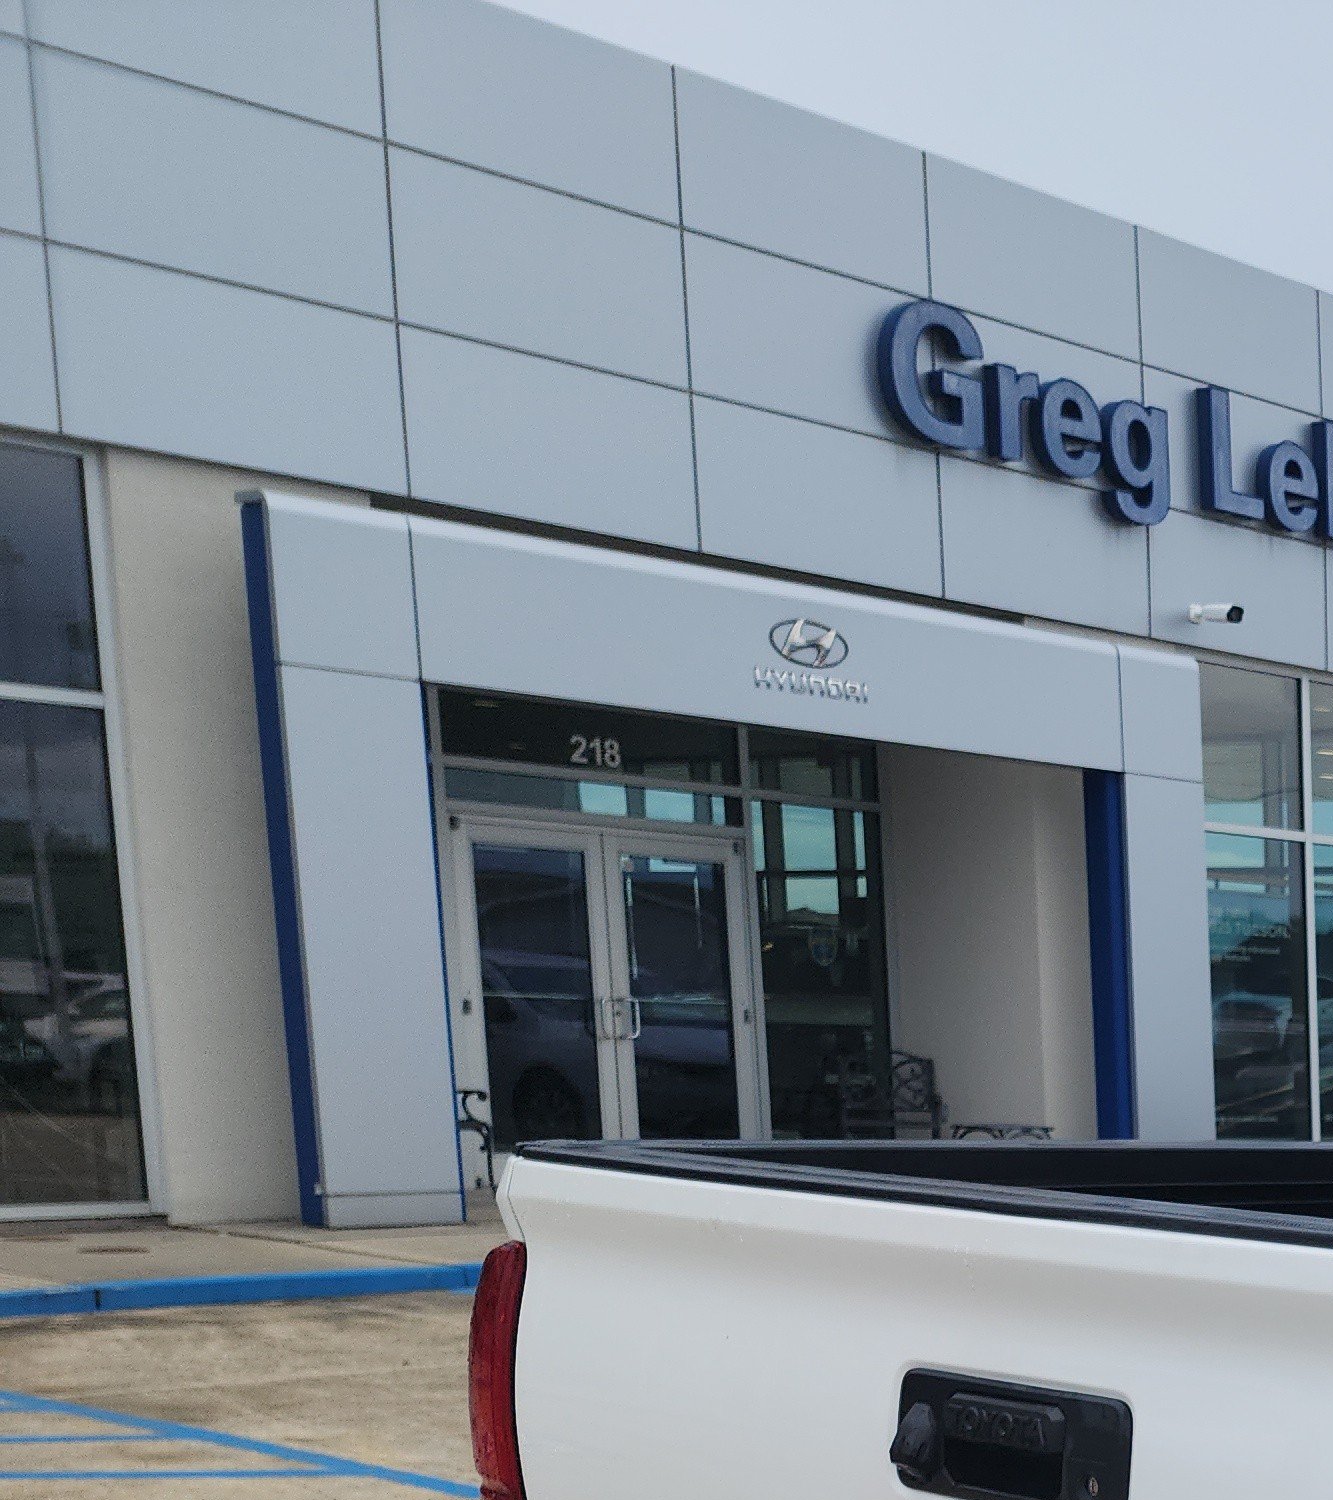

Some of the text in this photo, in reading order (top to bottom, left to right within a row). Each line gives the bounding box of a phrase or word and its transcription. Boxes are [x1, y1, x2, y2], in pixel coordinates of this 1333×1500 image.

[878, 300, 1169, 526] Greg
[754, 665, 868, 704] HYUNDAI
[570, 734, 621, 768] 218
